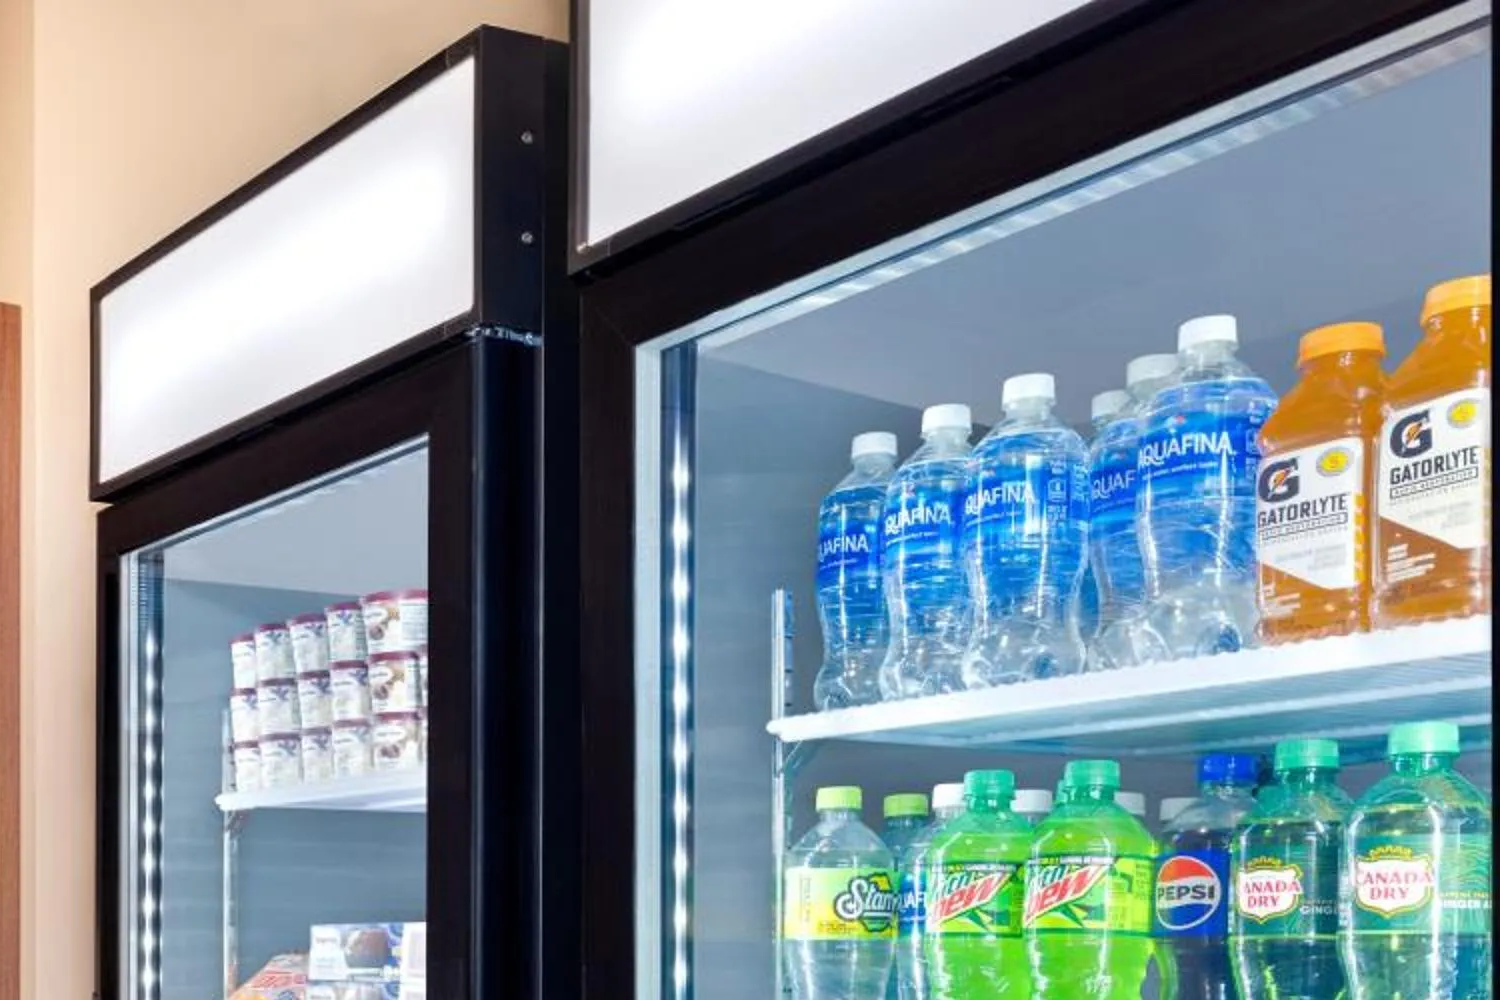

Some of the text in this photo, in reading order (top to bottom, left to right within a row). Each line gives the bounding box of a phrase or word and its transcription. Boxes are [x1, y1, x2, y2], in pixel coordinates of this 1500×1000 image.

[1390, 446, 1479, 484] GATORLYTE
[1257, 492, 1349, 527] GATORLYTE
[1241, 878, 1301, 895] ANADA
[1355, 870, 1436, 886] CANADA
[1158, 884, 1216, 901] PEPSI
[1369, 886, 1411, 901] DRY
[1247, 894, 1281, 909] DRY
